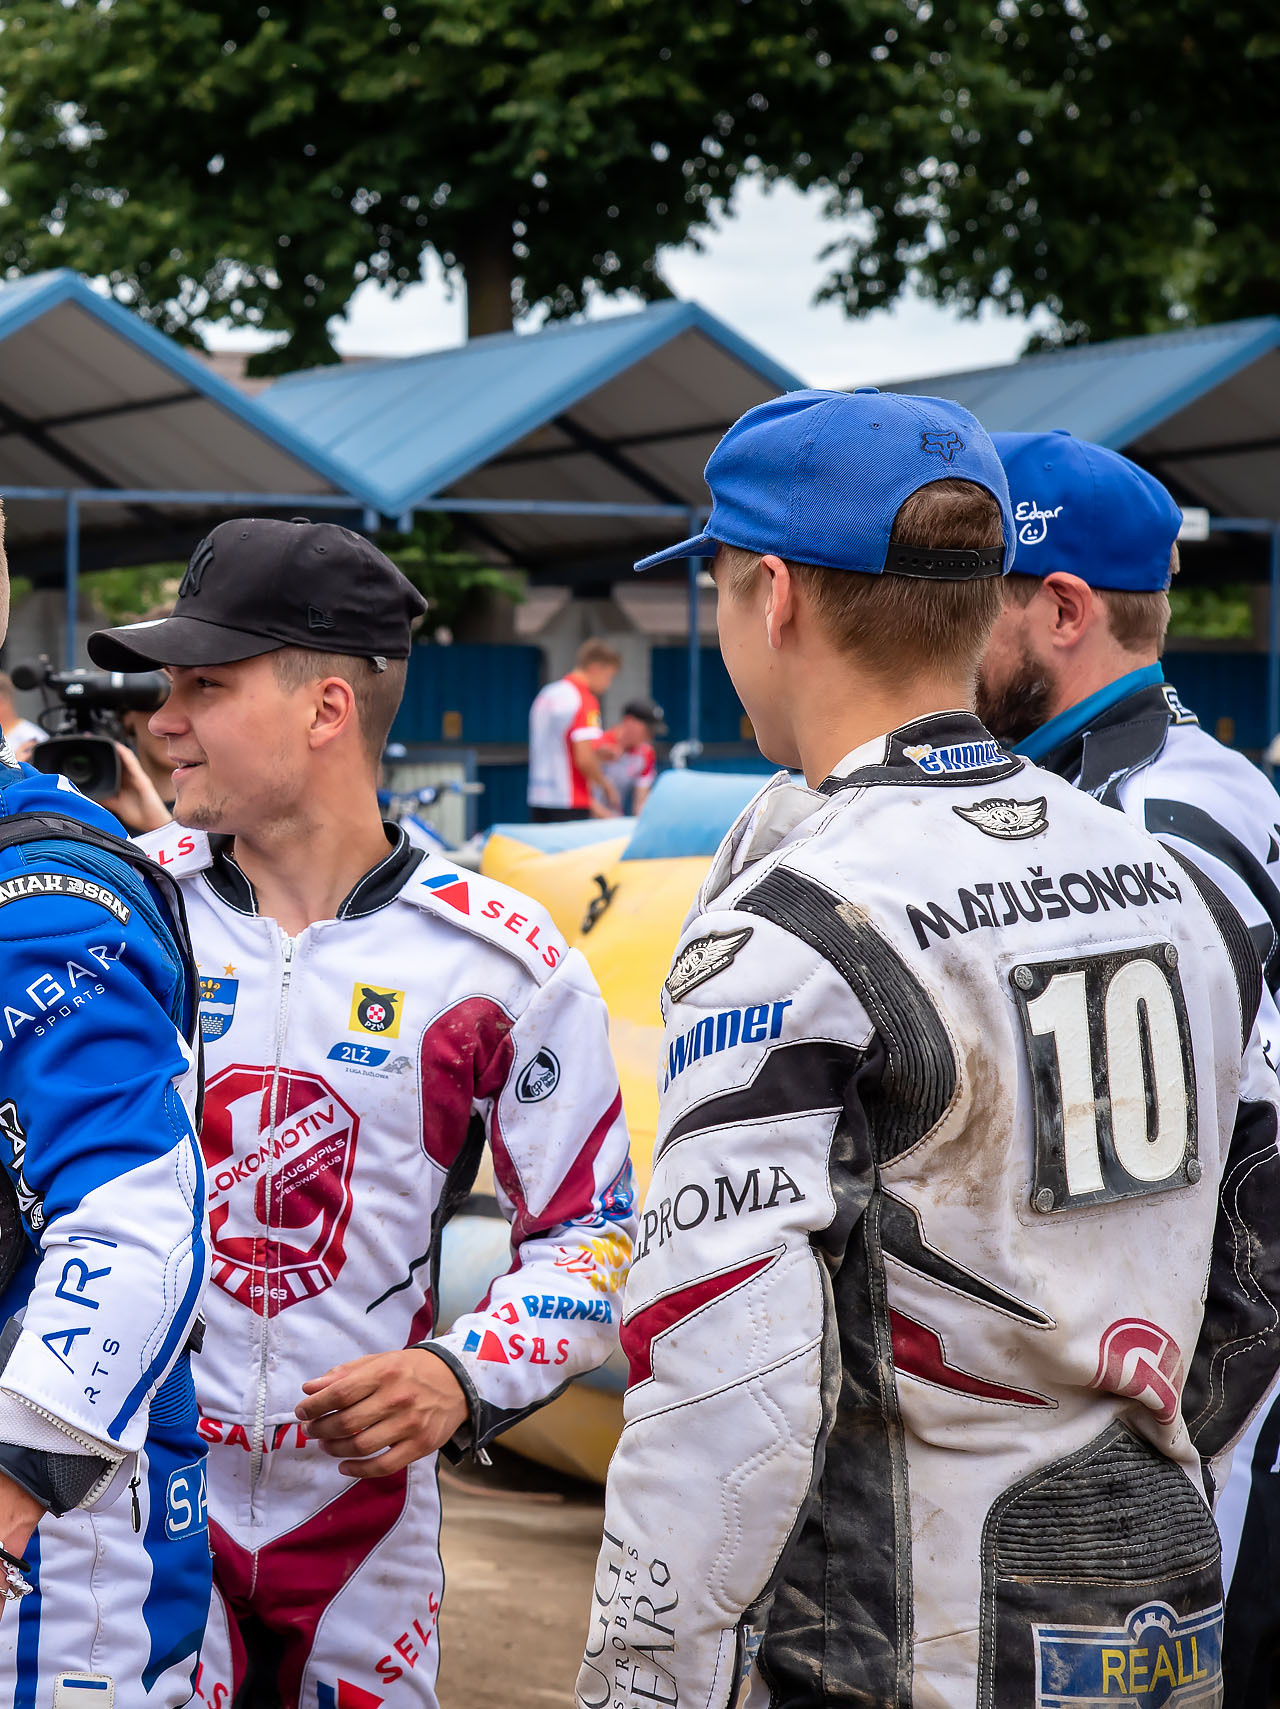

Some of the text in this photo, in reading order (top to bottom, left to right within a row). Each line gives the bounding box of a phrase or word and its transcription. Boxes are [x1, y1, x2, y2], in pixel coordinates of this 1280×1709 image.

[1015, 500, 1064, 545] Edgar
[146, 835, 196, 866] LS
[480, 899, 561, 969] SELS
[34, 983, 106, 1037] SPORTS
[363, 1020, 387, 1032] PZM
[341, 1046, 371, 1064] 2LŻ
[1026, 958, 1188, 1198] 10
[274, 1138, 346, 1191] DAUGAVPILS
[249, 1285, 288, 1301] 1963
[521, 1294, 613, 1325] BERNER
[375, 1592, 438, 1685] SELS
[1101, 1636, 1209, 1695] REALL
